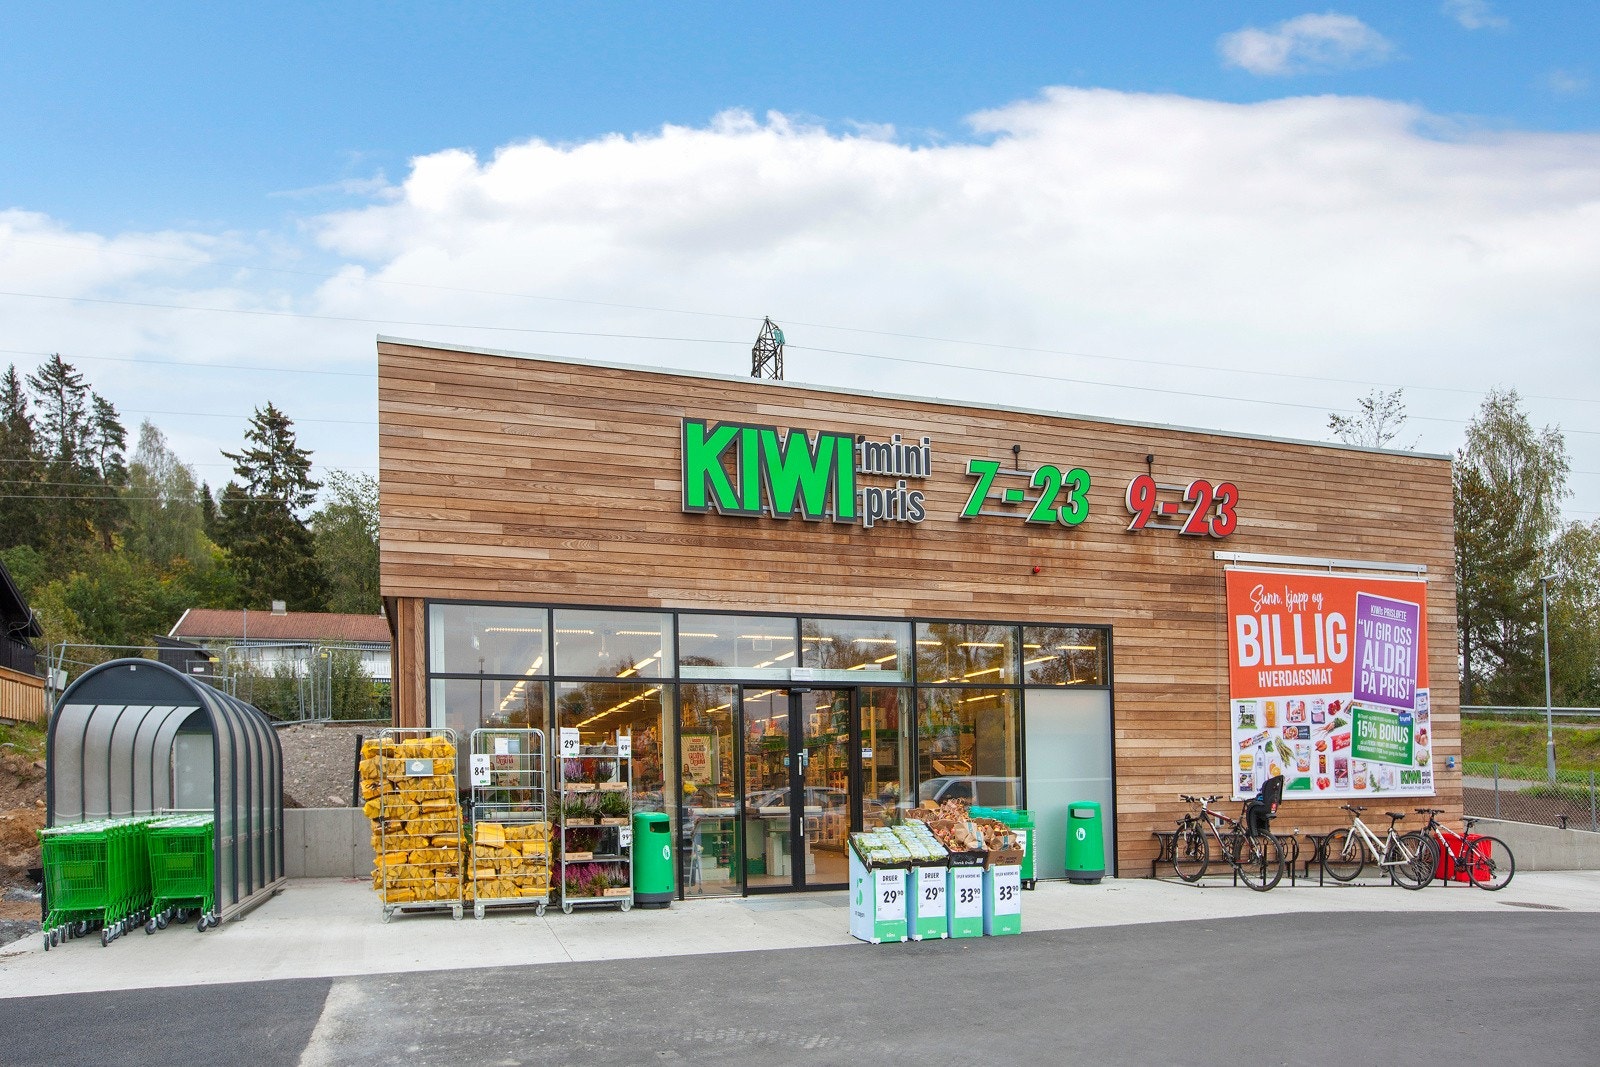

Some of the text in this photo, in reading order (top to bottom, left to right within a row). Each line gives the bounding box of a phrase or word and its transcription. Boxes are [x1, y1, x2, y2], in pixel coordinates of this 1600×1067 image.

[861, 434, 931, 478] mini
[682, 417, 858, 524] KIWI
[863, 480, 926, 528] pris
[1285, 585, 1309, 613] kjapp
[1311, 592, 1323, 611] og
[1235, 612, 1348, 667] BILLIG
[1375, 622, 1391, 643] GIR
[1393, 626, 1412, 646] OSS
[1362, 639, 1411, 677] ALDRI
[1258, 668, 1333, 688] HVERDAGSMAT
[1361, 665, 1377, 695] PÅ
[564, 740, 574, 748] 29
[1357, 720, 1377, 739] 15%
[1379, 723, 1409, 744] BONUS
[474, 767, 484, 776] 84
[883, 890, 897, 904] 29
[925, 888, 938, 900] 29
[960, 888, 974, 903] 33
[1000, 886, 1012, 900] 33
